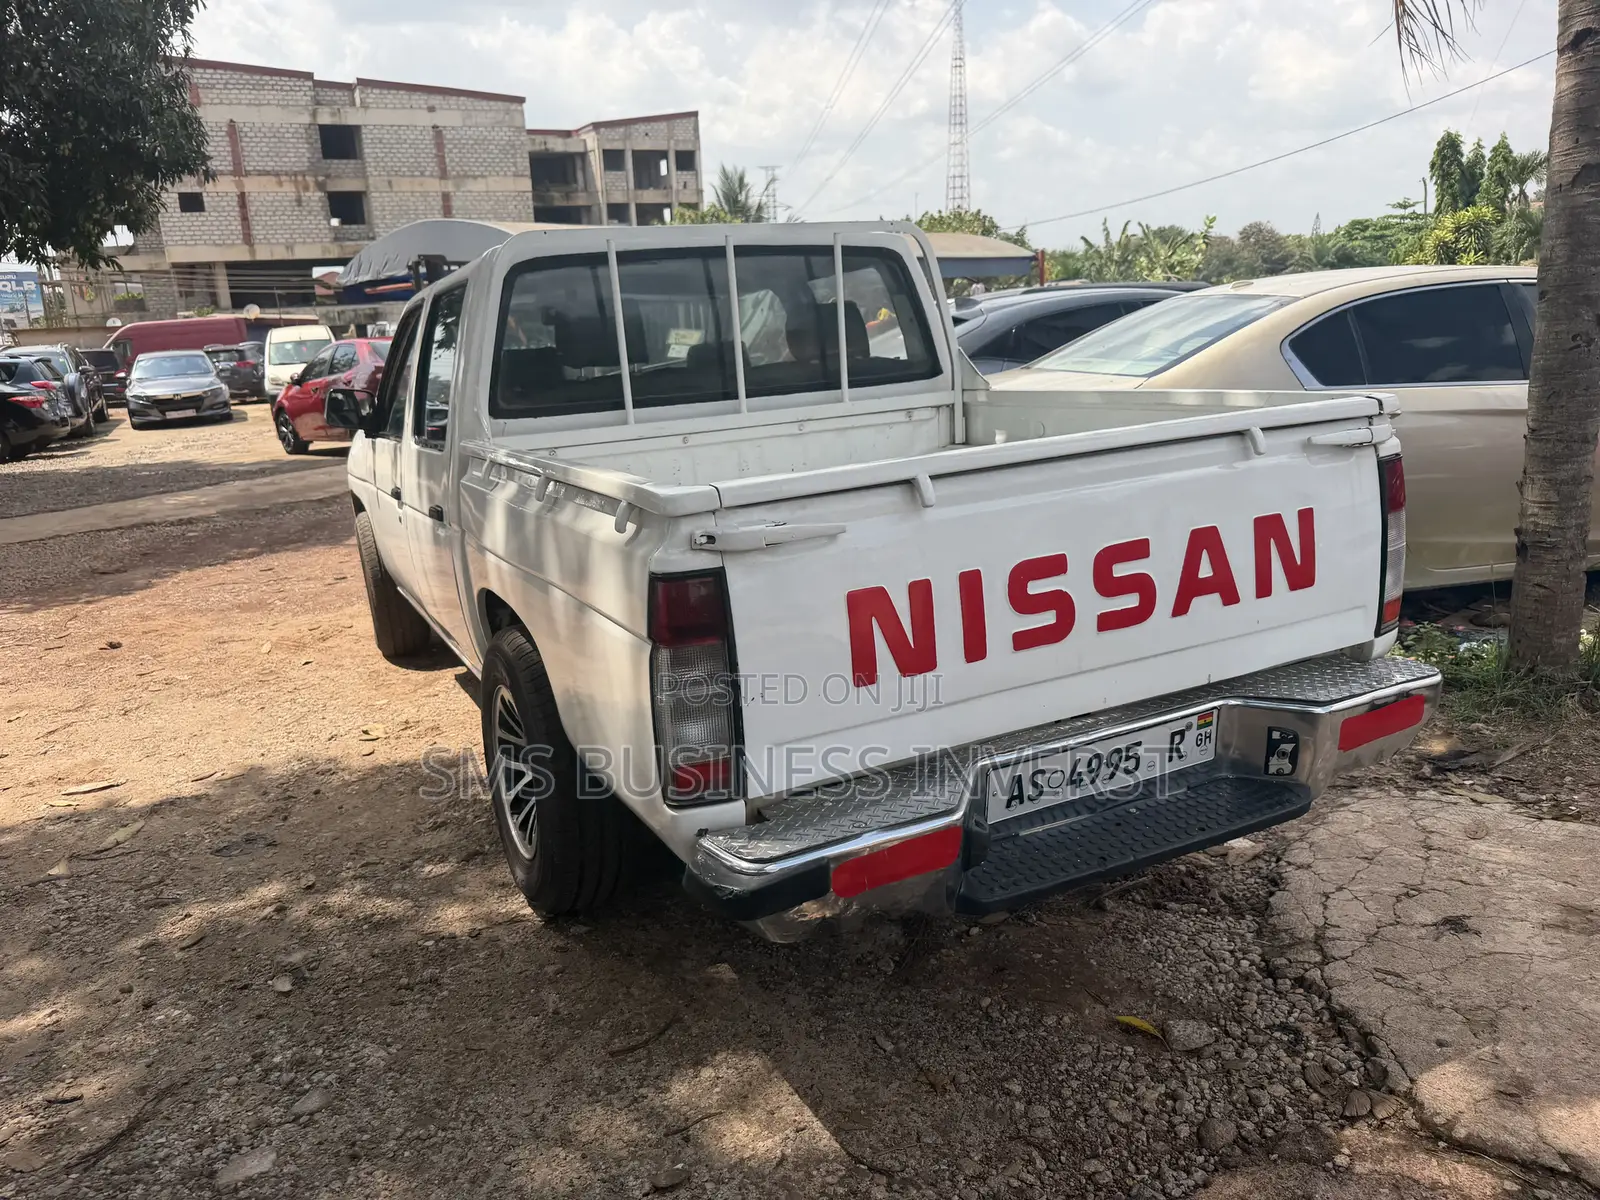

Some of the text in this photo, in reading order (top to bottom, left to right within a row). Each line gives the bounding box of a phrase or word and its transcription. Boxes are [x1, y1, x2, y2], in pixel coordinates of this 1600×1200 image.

[846, 506, 1316, 688] NISSAN
[1005, 729, 1187, 809] AS 4995 R
[1195, 730, 1212, 748] GH
